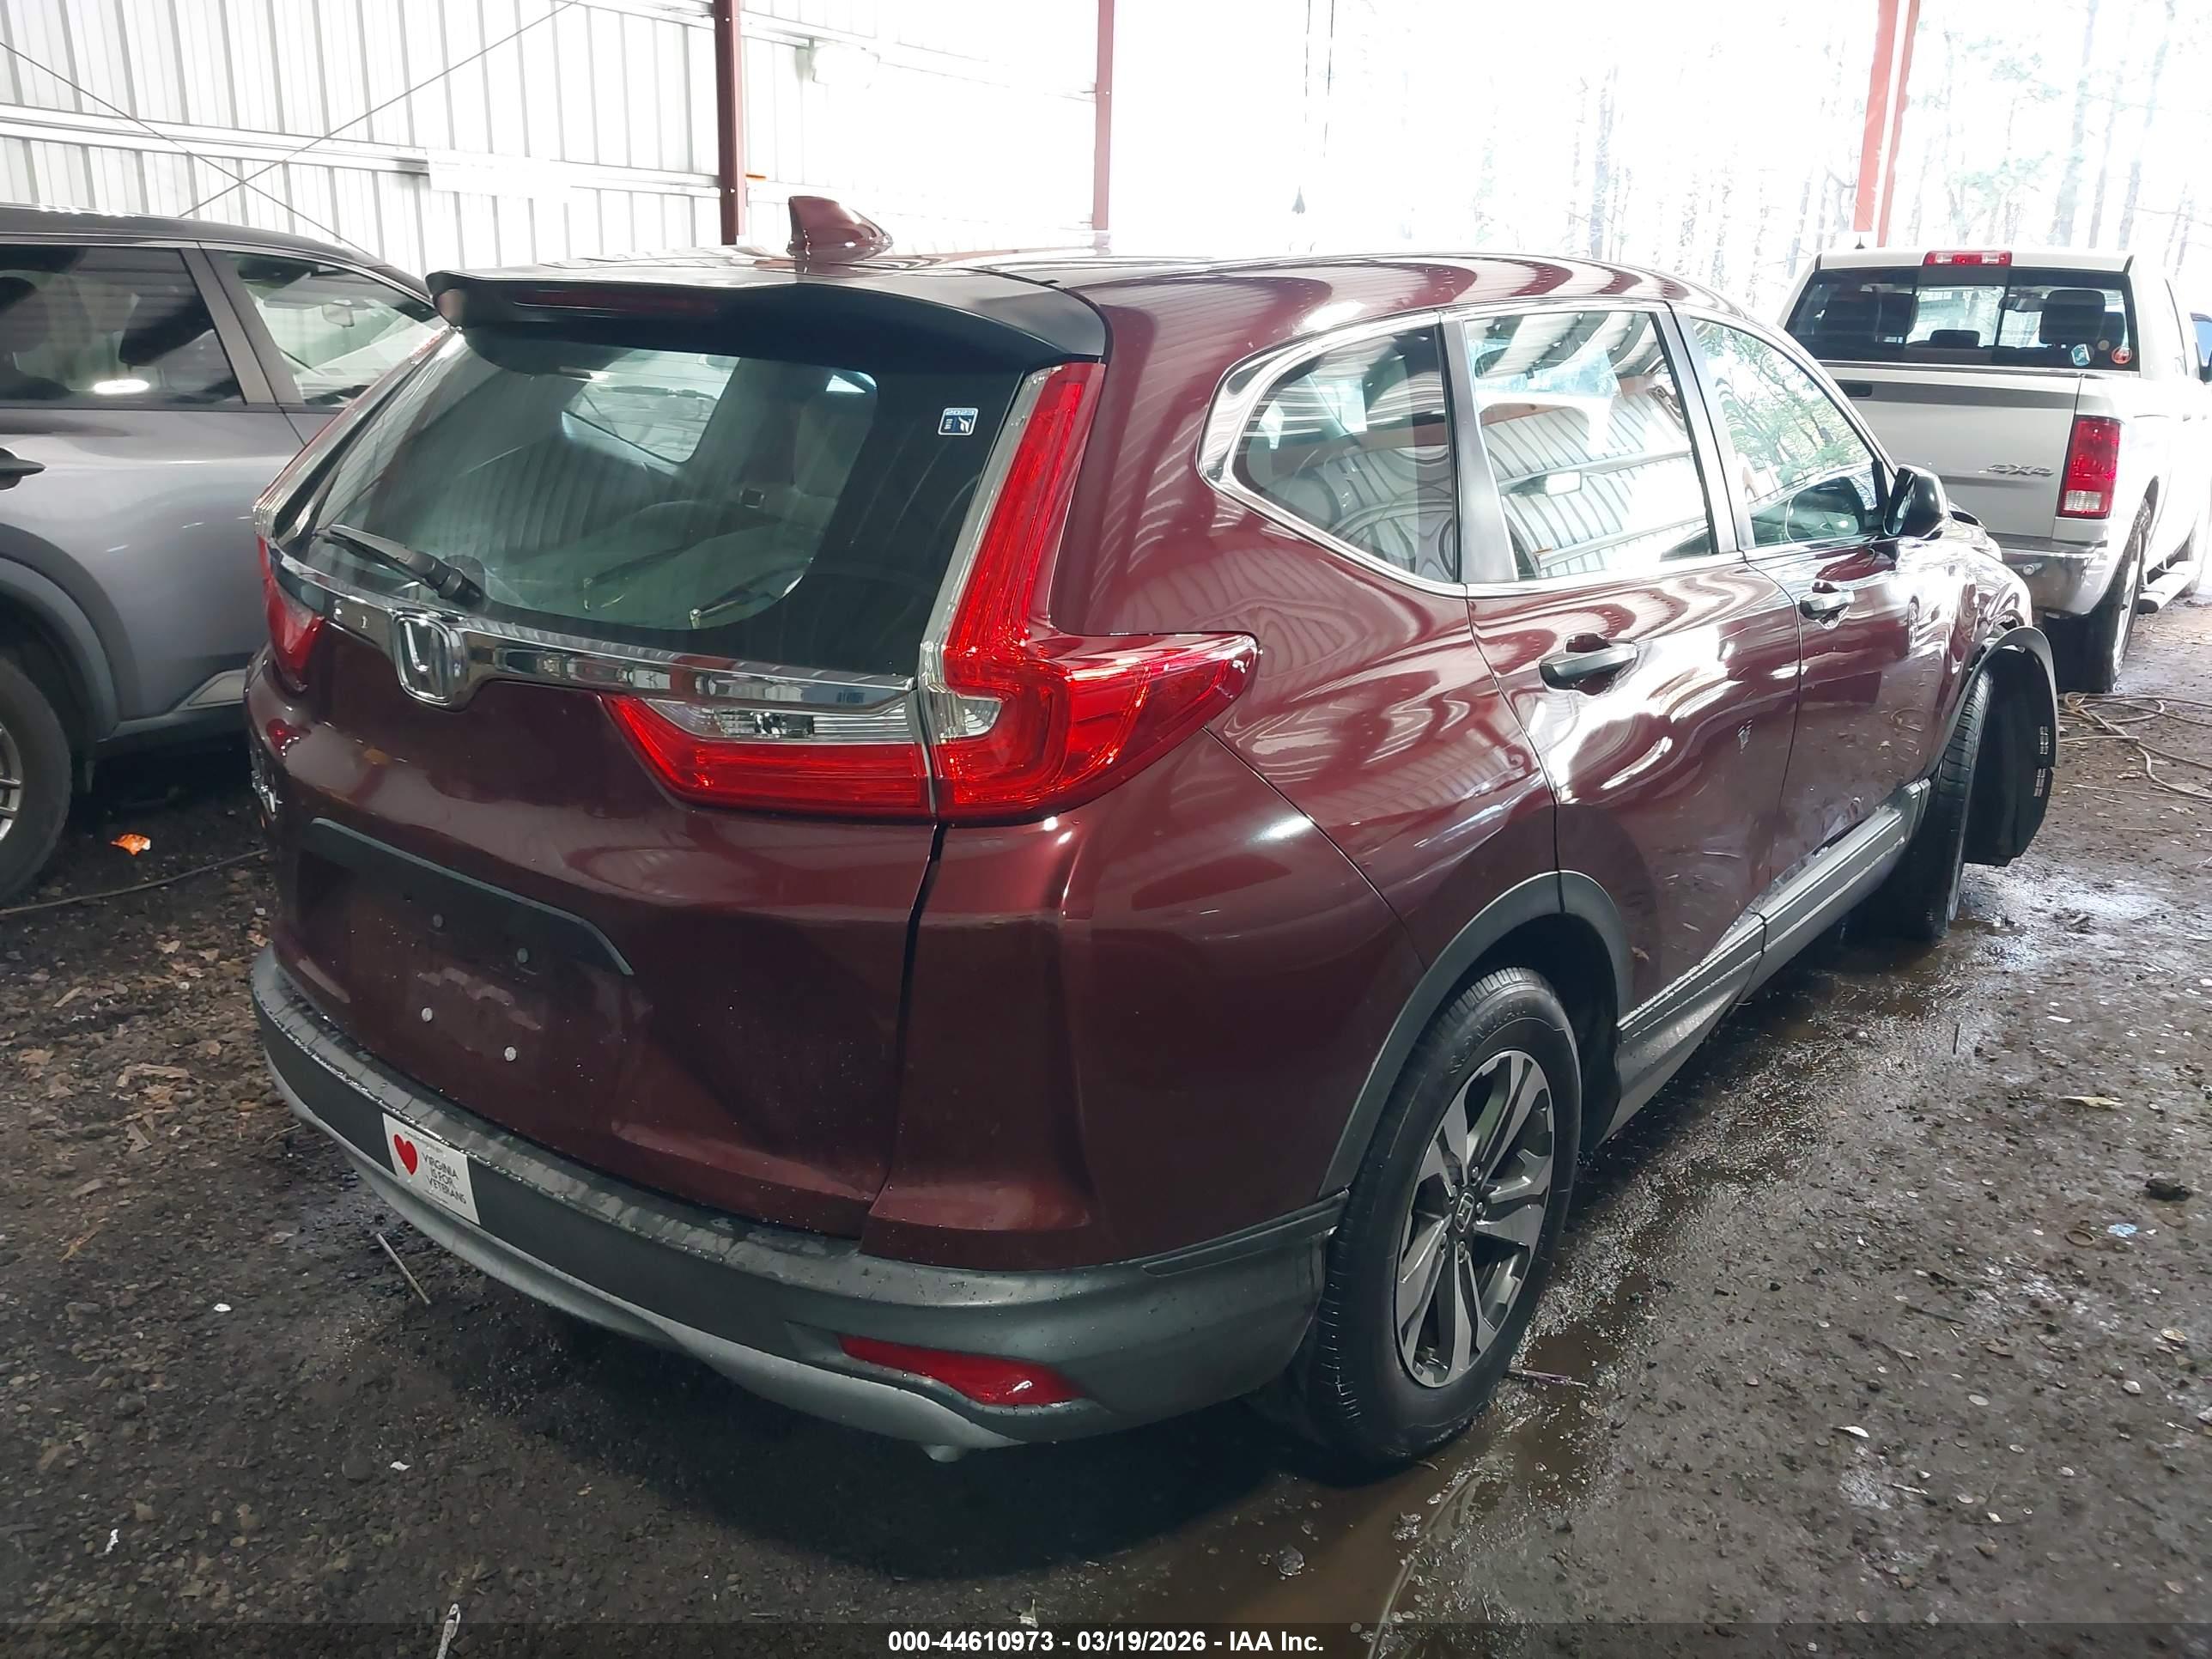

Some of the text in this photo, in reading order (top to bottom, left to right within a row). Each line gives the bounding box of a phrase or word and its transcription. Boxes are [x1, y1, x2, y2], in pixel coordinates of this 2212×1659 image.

[421, 1152, 459, 1181] VIRGINIA
[437, 1171, 456, 1188] FOR
[426, 1174, 467, 1205] VETERANS
